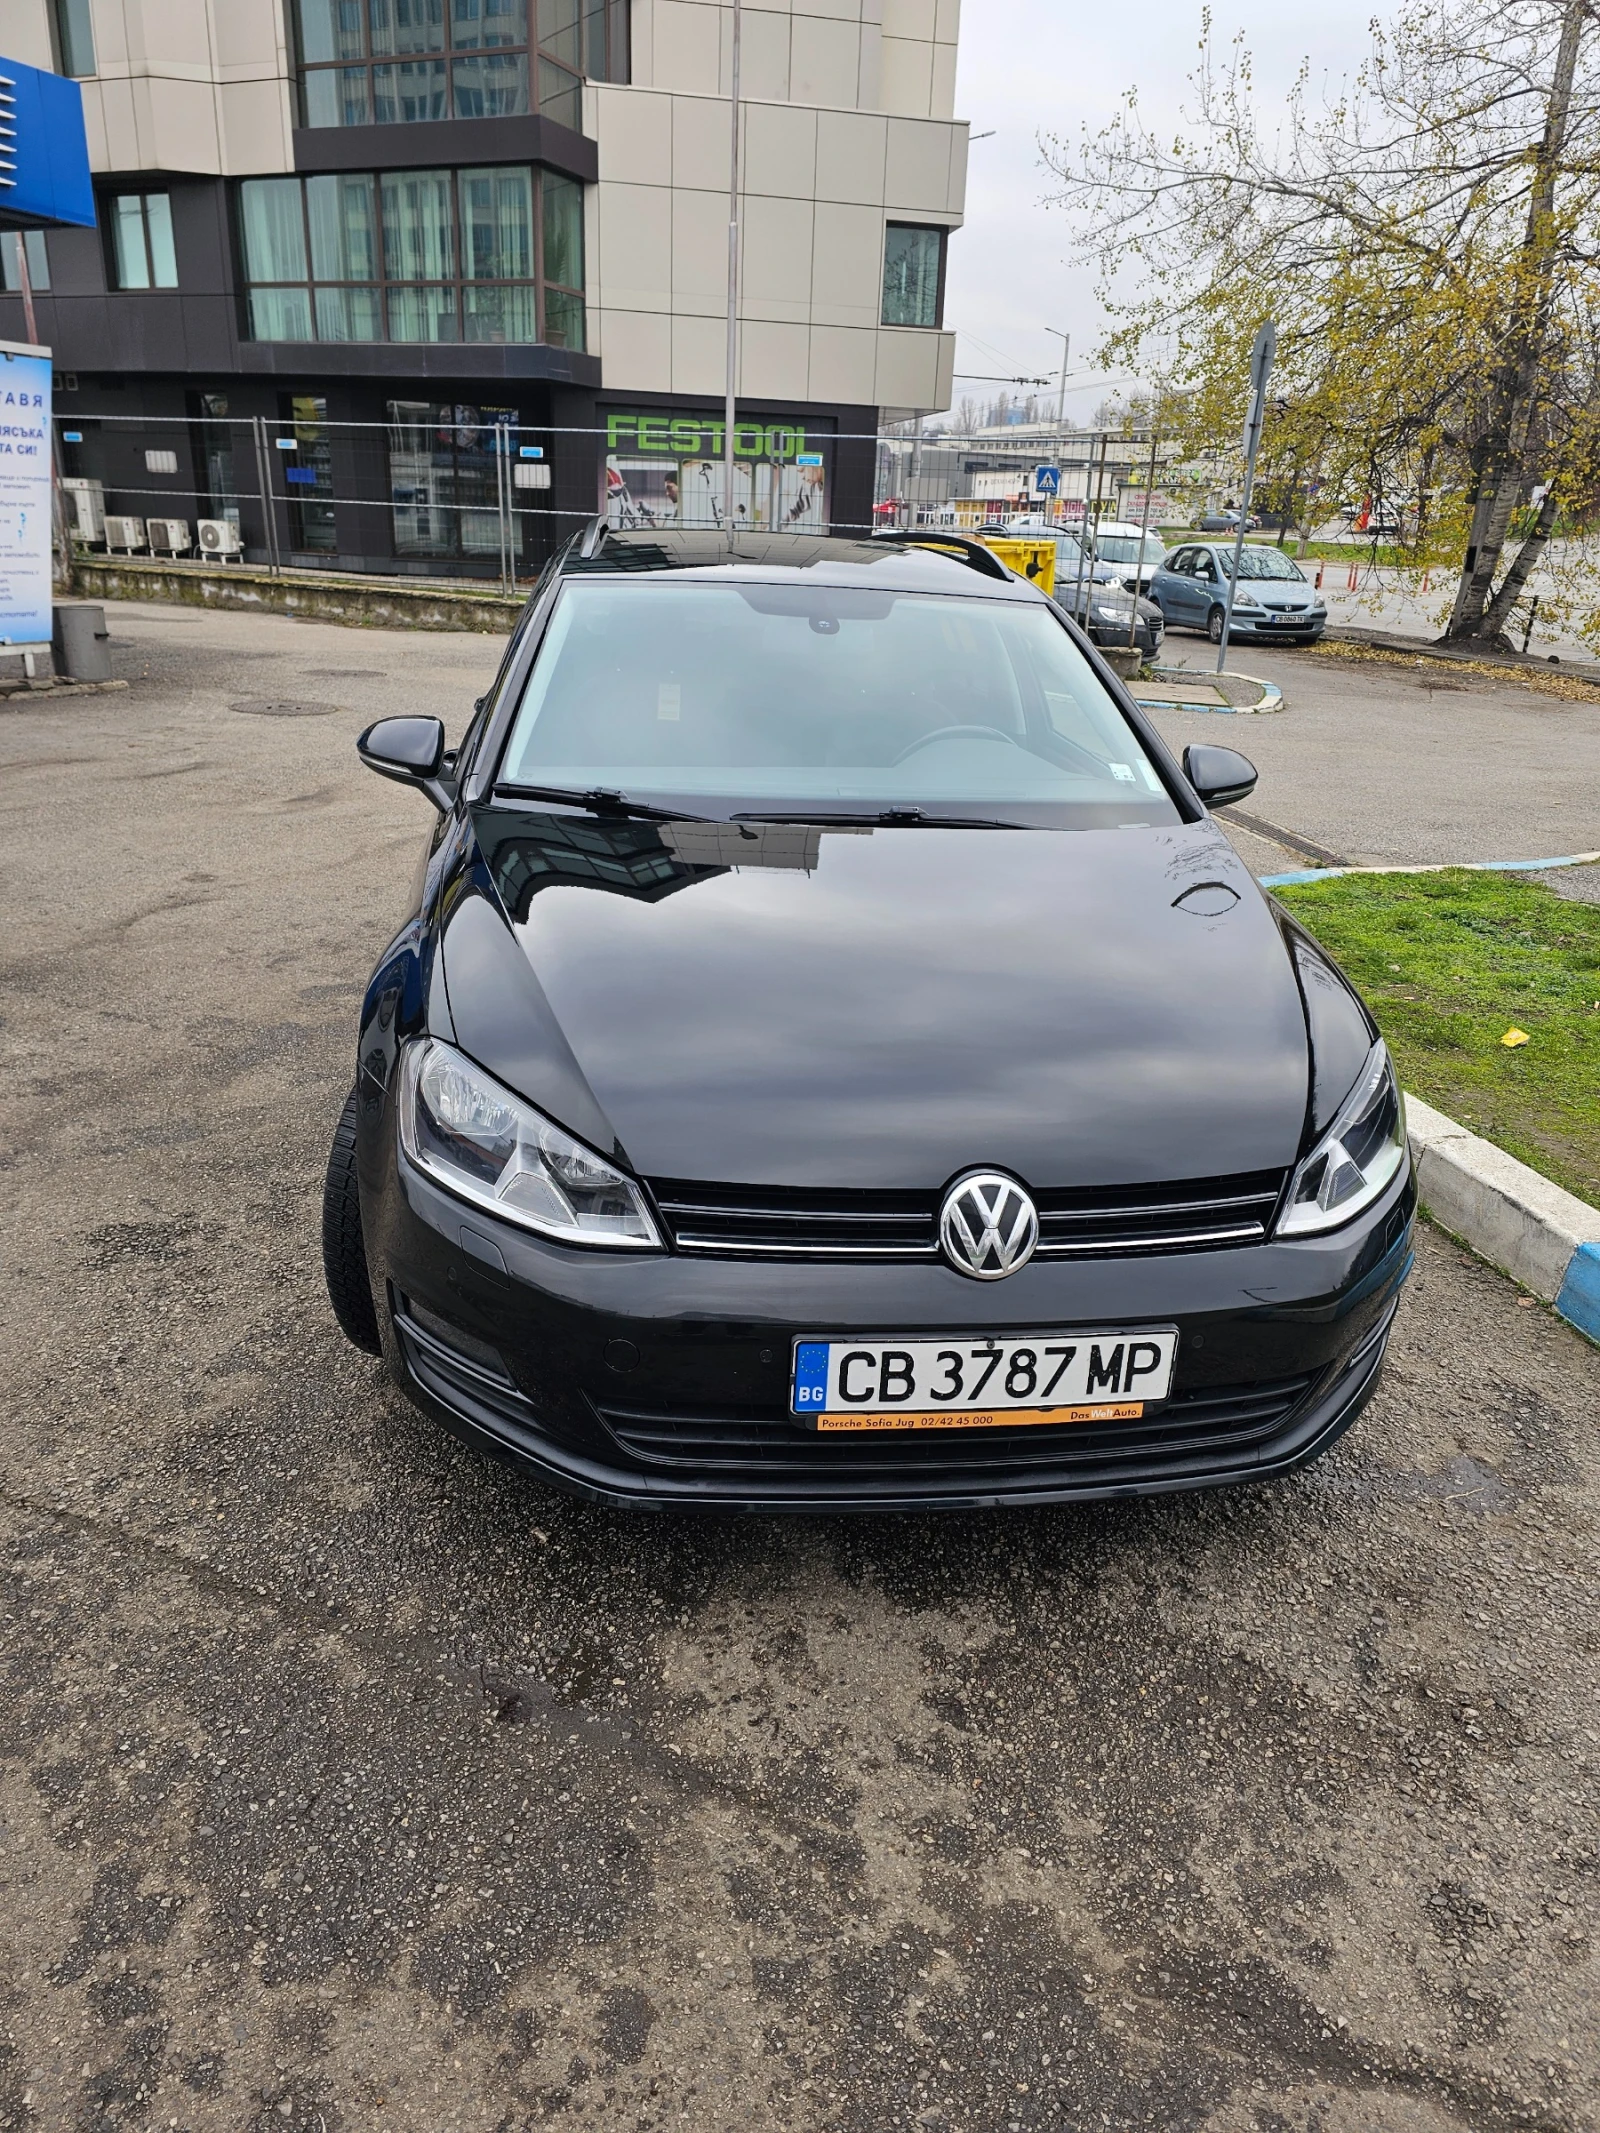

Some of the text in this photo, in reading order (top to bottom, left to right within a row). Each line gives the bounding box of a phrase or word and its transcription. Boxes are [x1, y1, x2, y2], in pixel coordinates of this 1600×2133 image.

[0, 391, 43, 408] АВЯ
[0, 425, 44, 440] ЯСЪКА
[607, 414, 824, 457] FESTOOL
[930, 1346, 1077, 1401] 3787
[798, 1386, 824, 1402] BG
[822, 1415, 993, 1428] Porsche Sofia Jug 02/42 45 000
[1070, 1411, 1090, 1420] Das
